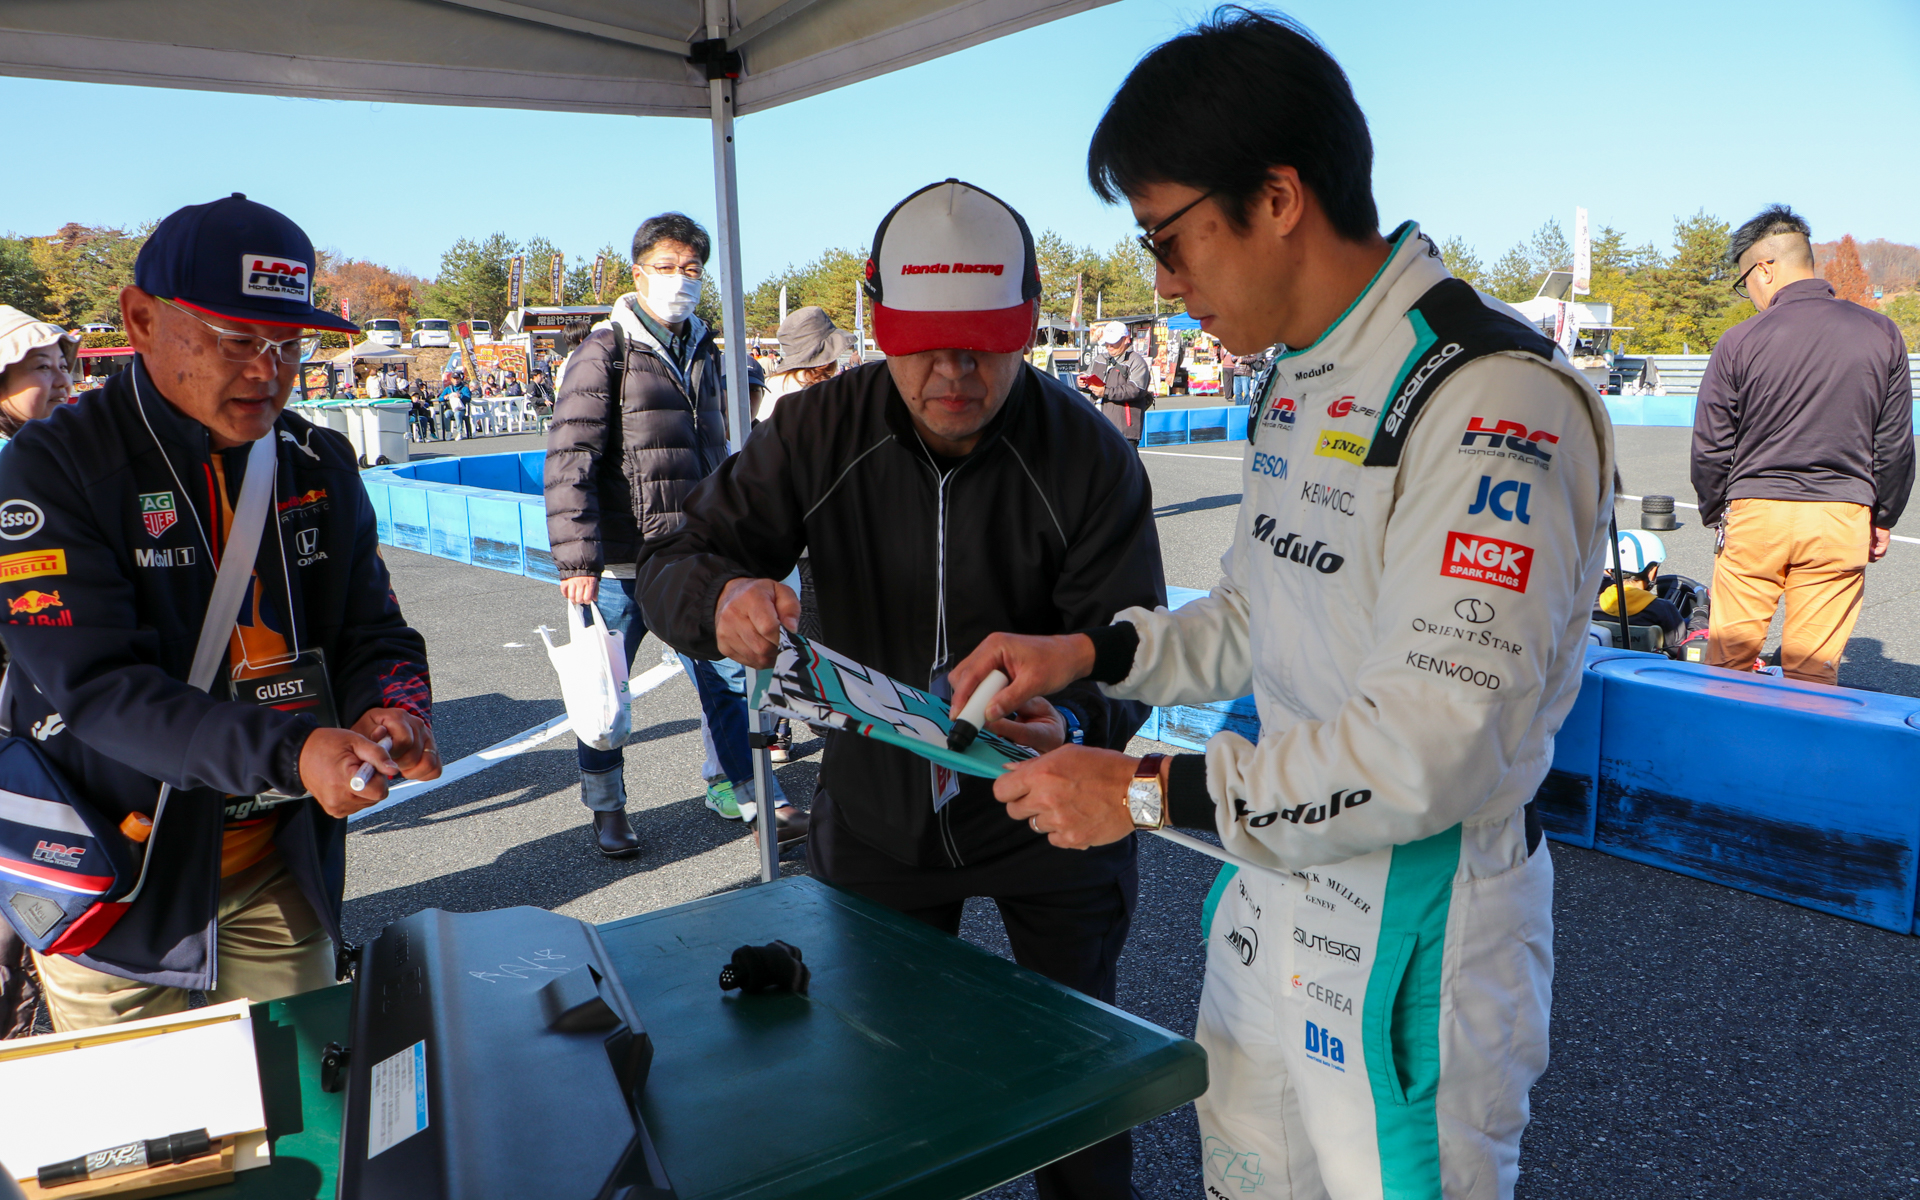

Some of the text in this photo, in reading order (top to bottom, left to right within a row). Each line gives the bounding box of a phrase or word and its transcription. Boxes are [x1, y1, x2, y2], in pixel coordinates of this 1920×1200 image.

[249, 260, 306, 289] HRC
[901, 263, 1004, 276] Honda Racing
[248, 284, 280, 292] Honda
[1295, 363, 1334, 381] Modulo
[1461, 416, 1560, 462] HRC
[1458, 448, 1550, 471] Honda RACING
[140, 495, 172, 511] AG
[1252, 513, 1344, 575] Mdulo
[1452, 537, 1525, 576] NGK
[1449, 565, 1520, 588] SPARK PLUGS
[1406, 651, 1500, 690] KENWOOD
[256, 679, 304, 700] GUEST
[33, 840, 86, 864] HRC
[1305, 894, 1337, 912] GENEVE
[1326, 878, 1371, 914] MULLER
[1306, 981, 1353, 1016] CEREA
[1305, 1019, 1345, 1064] Dfa
